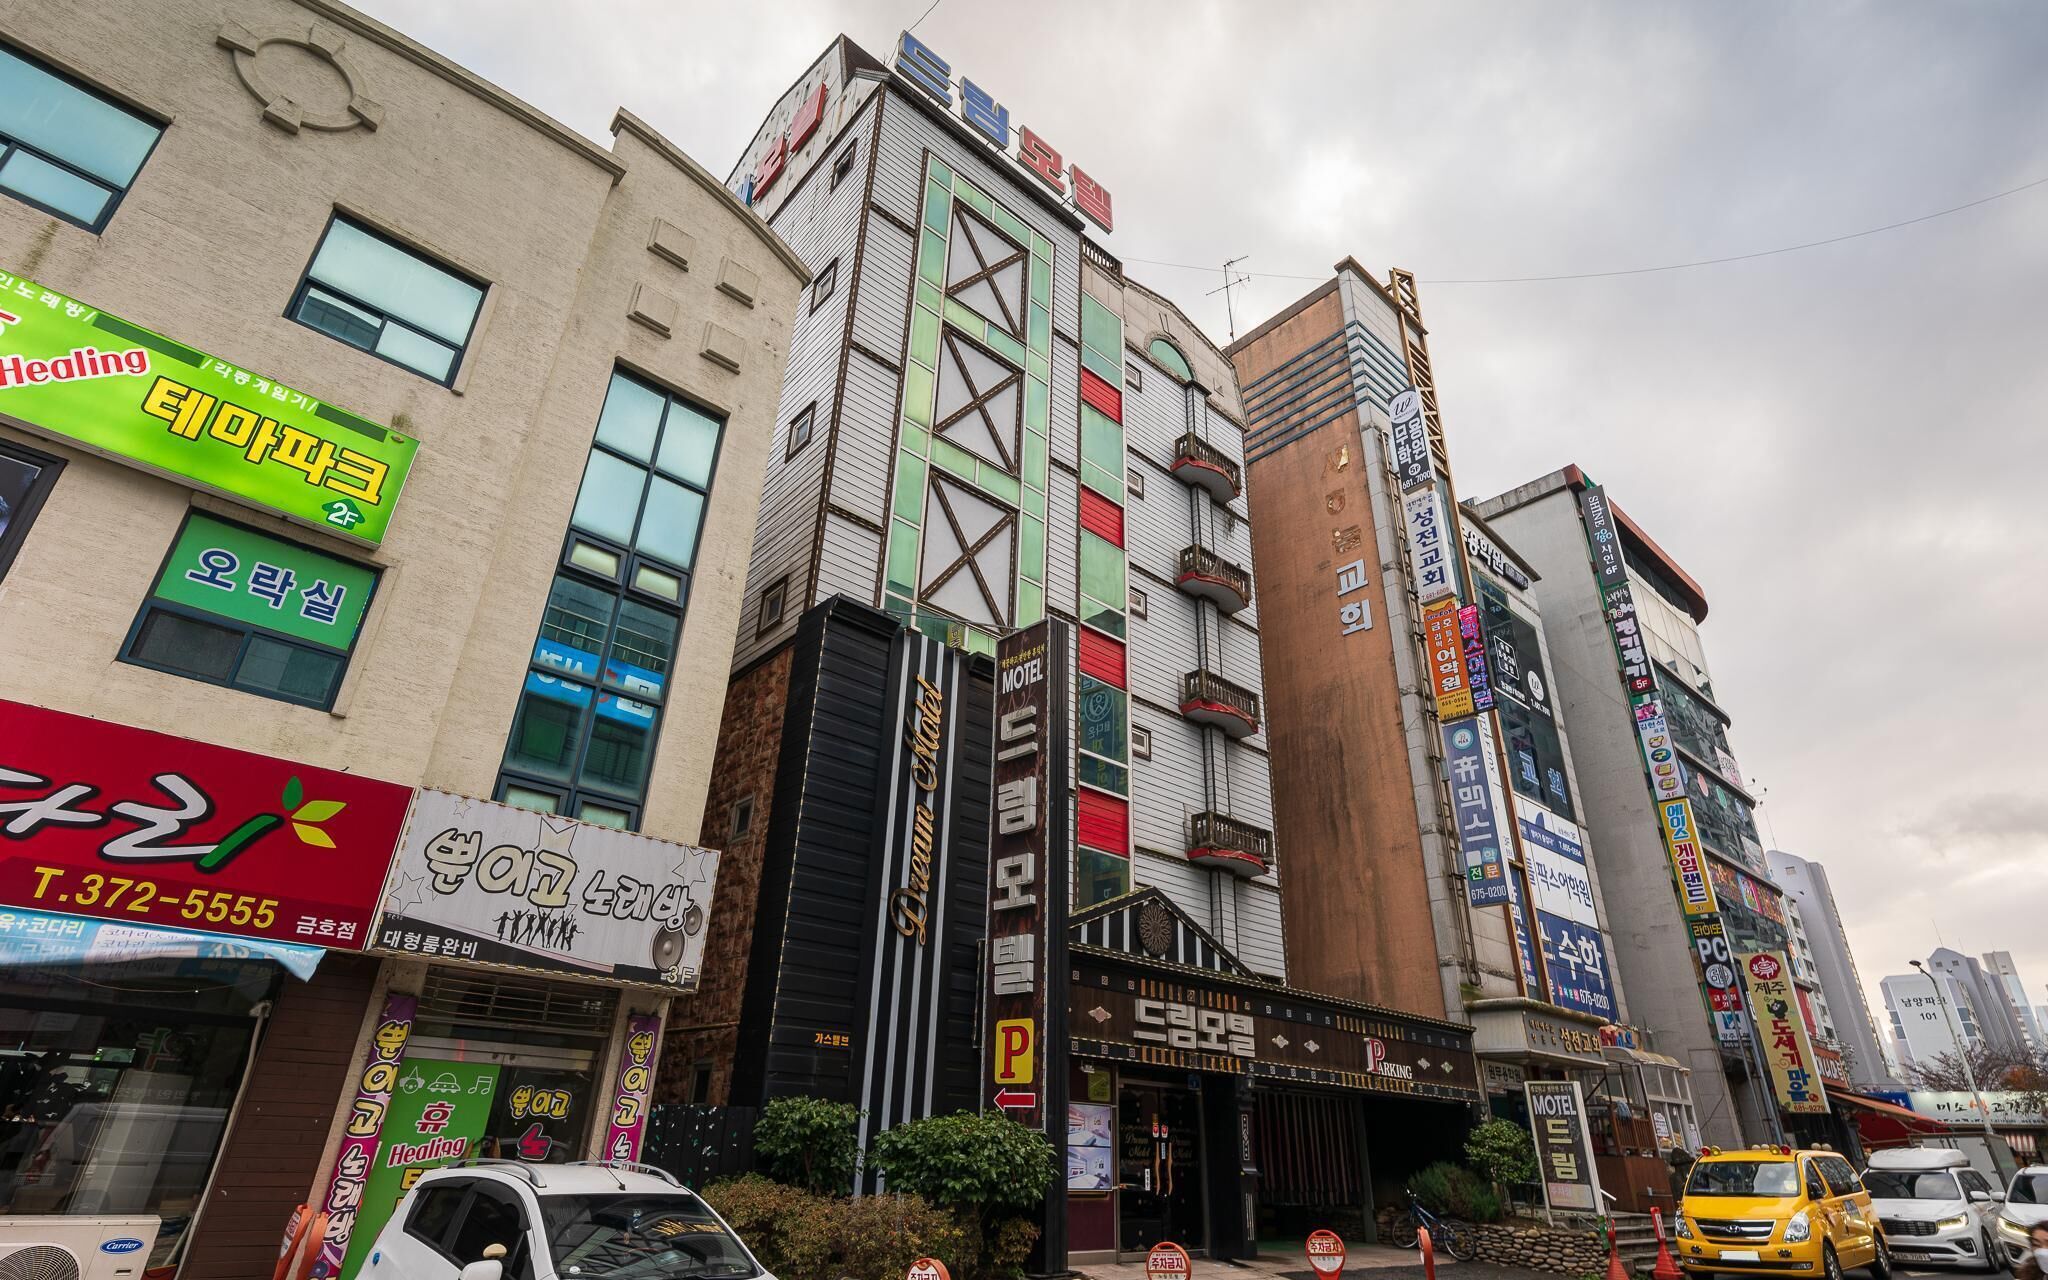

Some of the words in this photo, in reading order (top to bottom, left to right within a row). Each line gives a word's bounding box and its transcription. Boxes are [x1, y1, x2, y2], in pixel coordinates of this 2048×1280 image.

[895, 30, 1113, 235] 드림모텔
[0, 347, 149, 388] Healing
[141, 375, 390, 506] 테마파크
[328, 502, 359, 526] 2F
[1589, 495, 1605, 528] SHINE
[1412, 506, 1446, 588] 성전교회
[186, 548, 346, 625] 오락실
[1605, 564, 1618, 575] 6F
[1002, 657, 1044, 695] MOTEL
[1436, 645, 1462, 692] 어학원
[1636, 679, 1648, 689] 5F
[905, 672, 944, 792] Motel
[1453, 756, 1492, 842] 휴맥스
[1666, 803, 1690, 841] 에이스
[993, 705, 1039, 995] 드림모텔
[889, 800, 936, 946] Dream
[1471, 884, 1507, 900] 675-0200
[1674, 842, 1709, 905] 게임랜드
[31, 866, 279, 929] T.372-5555
[582, 868, 695, 931] 노래방
[295, 915, 358, 941] 금호점
[382, 929, 479, 959] 대형룸완비
[1558, 929, 1607, 992] 수학
[1697, 936, 1729, 963] PC
[665, 964, 695, 986] 3F
[1754, 981, 1787, 996] 제주
[1133, 998, 1257, 1058] 드림모텔
[1919, 1012, 1938, 1021] 101
[1000, 1025, 1030, 1079] P
[1364, 1037, 1413, 1081] PARKING
[416, 1101, 456, 1134] 휴
[1532, 1095, 1577, 1116] MOTEL
[386, 1136, 468, 1168] Healing
[1545, 1119, 1579, 1180] 드림
[324, 1143, 369, 1247] 노래방
[105, 1240, 140, 1252] Carrier
[1151, 1257, 1184, 1270] 주차금지
